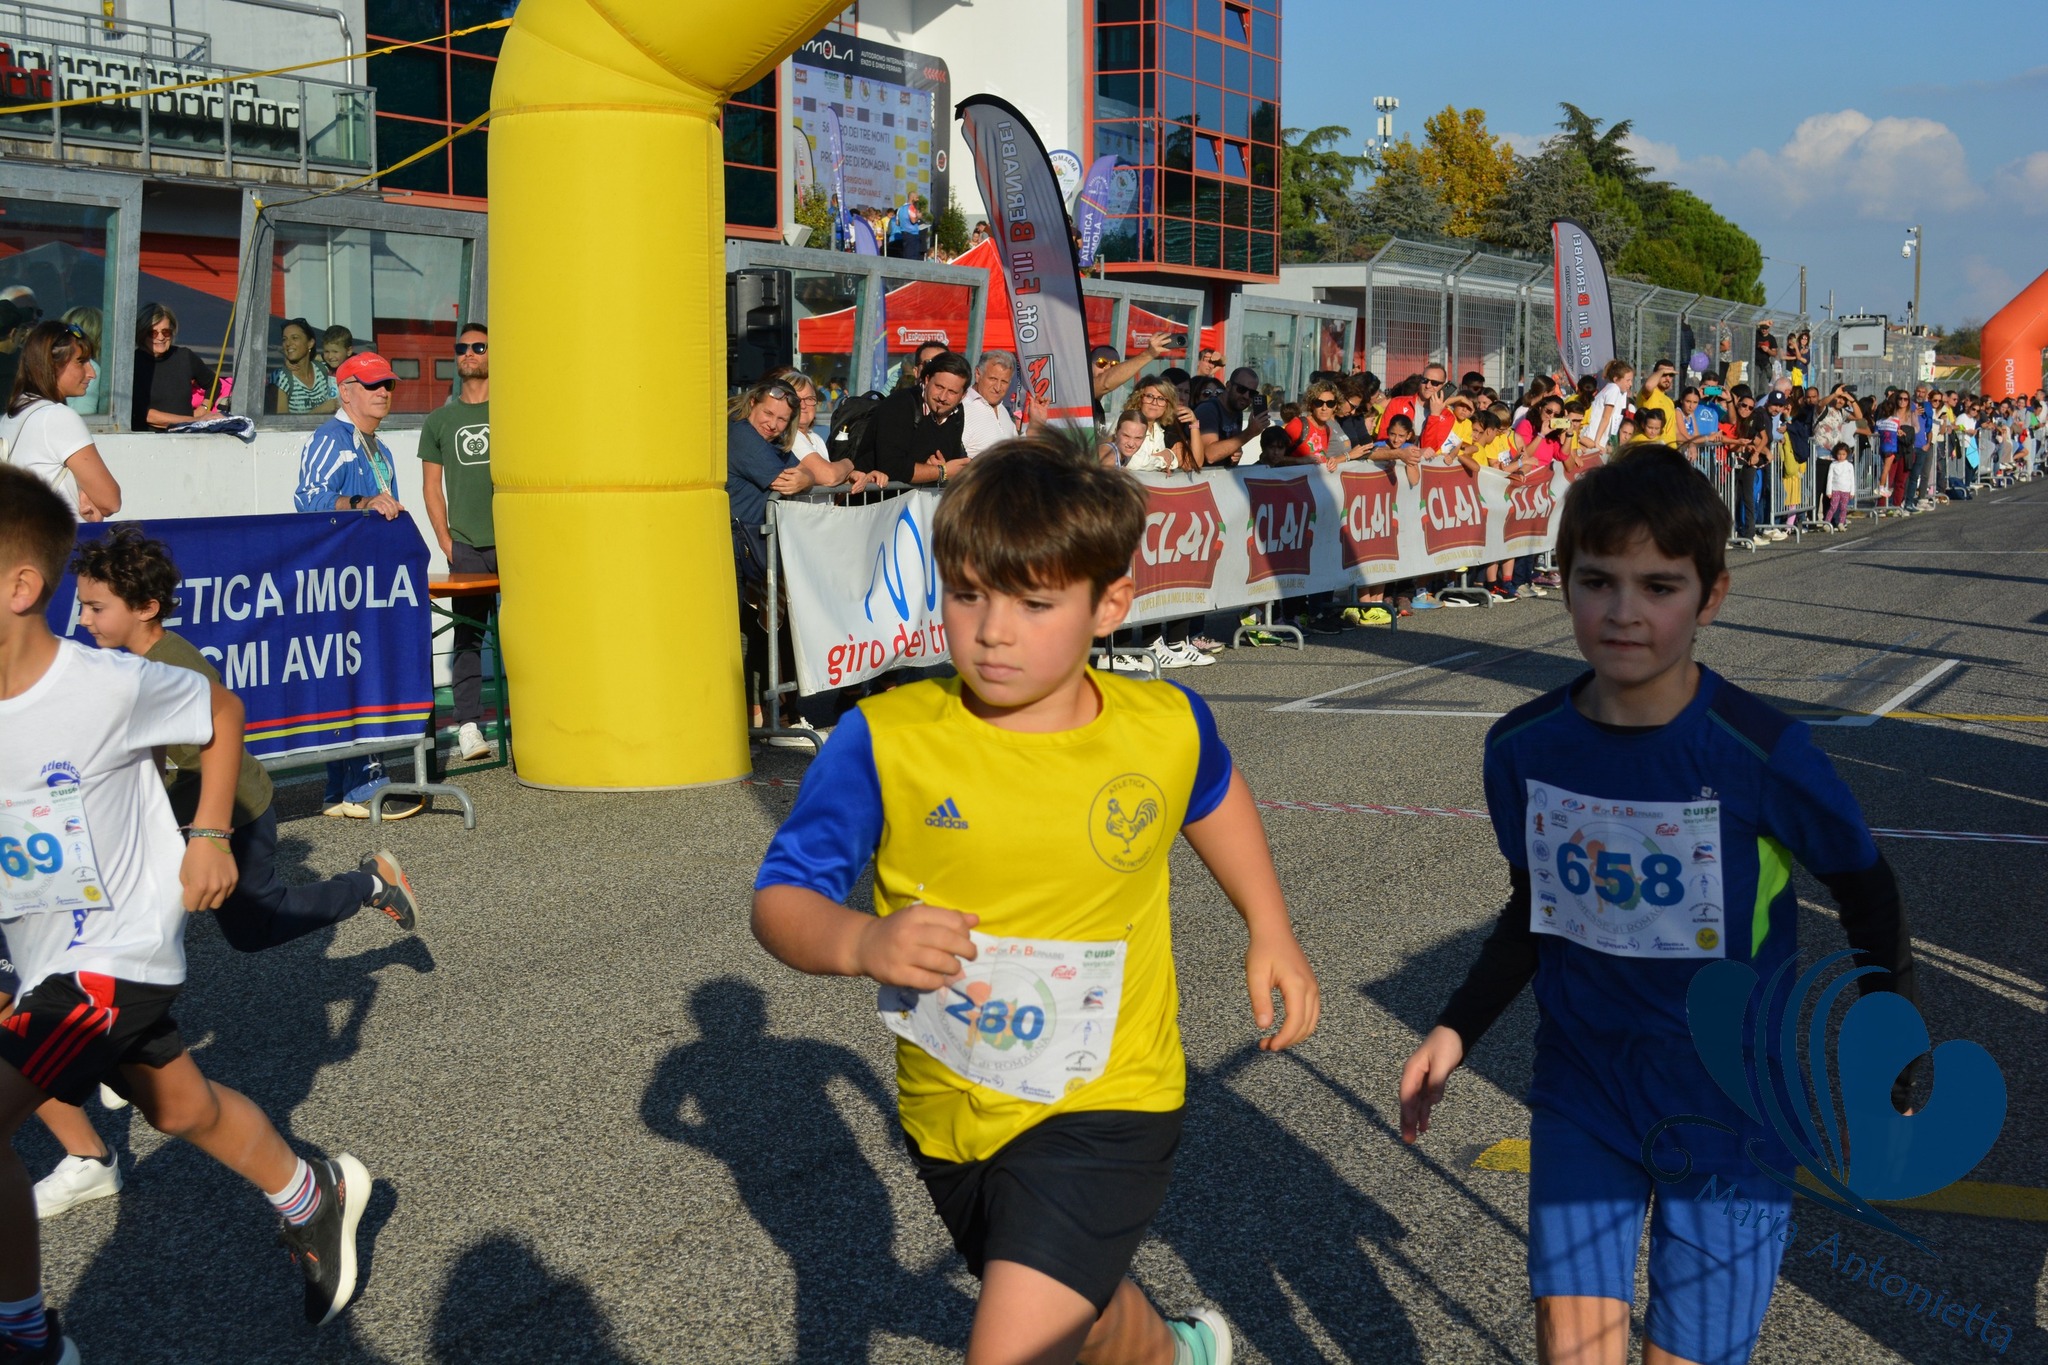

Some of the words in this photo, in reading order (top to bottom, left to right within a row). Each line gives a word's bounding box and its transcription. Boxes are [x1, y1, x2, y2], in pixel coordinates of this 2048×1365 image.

[860, 58, 872, 67] ENZO
[875, 61, 886, 70] DINO
[886, 64, 902, 74] FERRARI
[861, 50, 886, 62] AUTODROMO
[886, 56, 918, 70] INTERNAZIONALE
[822, 121, 830, 133] 56
[849, 126, 859, 138] DEI
[860, 128, 871, 141] TRE
[871, 130, 890, 144] MONTI
[845, 142, 859, 153] GRAN
[859, 144, 876, 156] PREMIO
[861, 157, 891, 172] ROMAGNA
[1081, 212, 1094, 262] ATLETICA
[2004, 358, 2015, 395] POWER
[1349, 492, 1391, 543] CLAI
[1427, 484, 1482, 531] CLAI
[1510, 481, 1552, 521] CLAI
[1140, 510, 1216, 566] CLAI
[1255, 501, 1309, 556] CLAI
[295, 564, 419, 614] IMOLA
[281, 630, 363, 684] AVIS
[827, 635, 886, 686] giro
[893, 622, 926, 659] dei
[39, 760, 81, 780] Atletica
[1108, 778, 1146, 797] ATLETICA
[924, 816, 969, 830] adidas
[1693, 807, 1717, 816] UISP
[0, 832, 64, 878] 69
[1556, 842, 1685, 907] 658
[1094, 949, 1116, 959] UISP
[944, 985, 1045, 1041] 280
